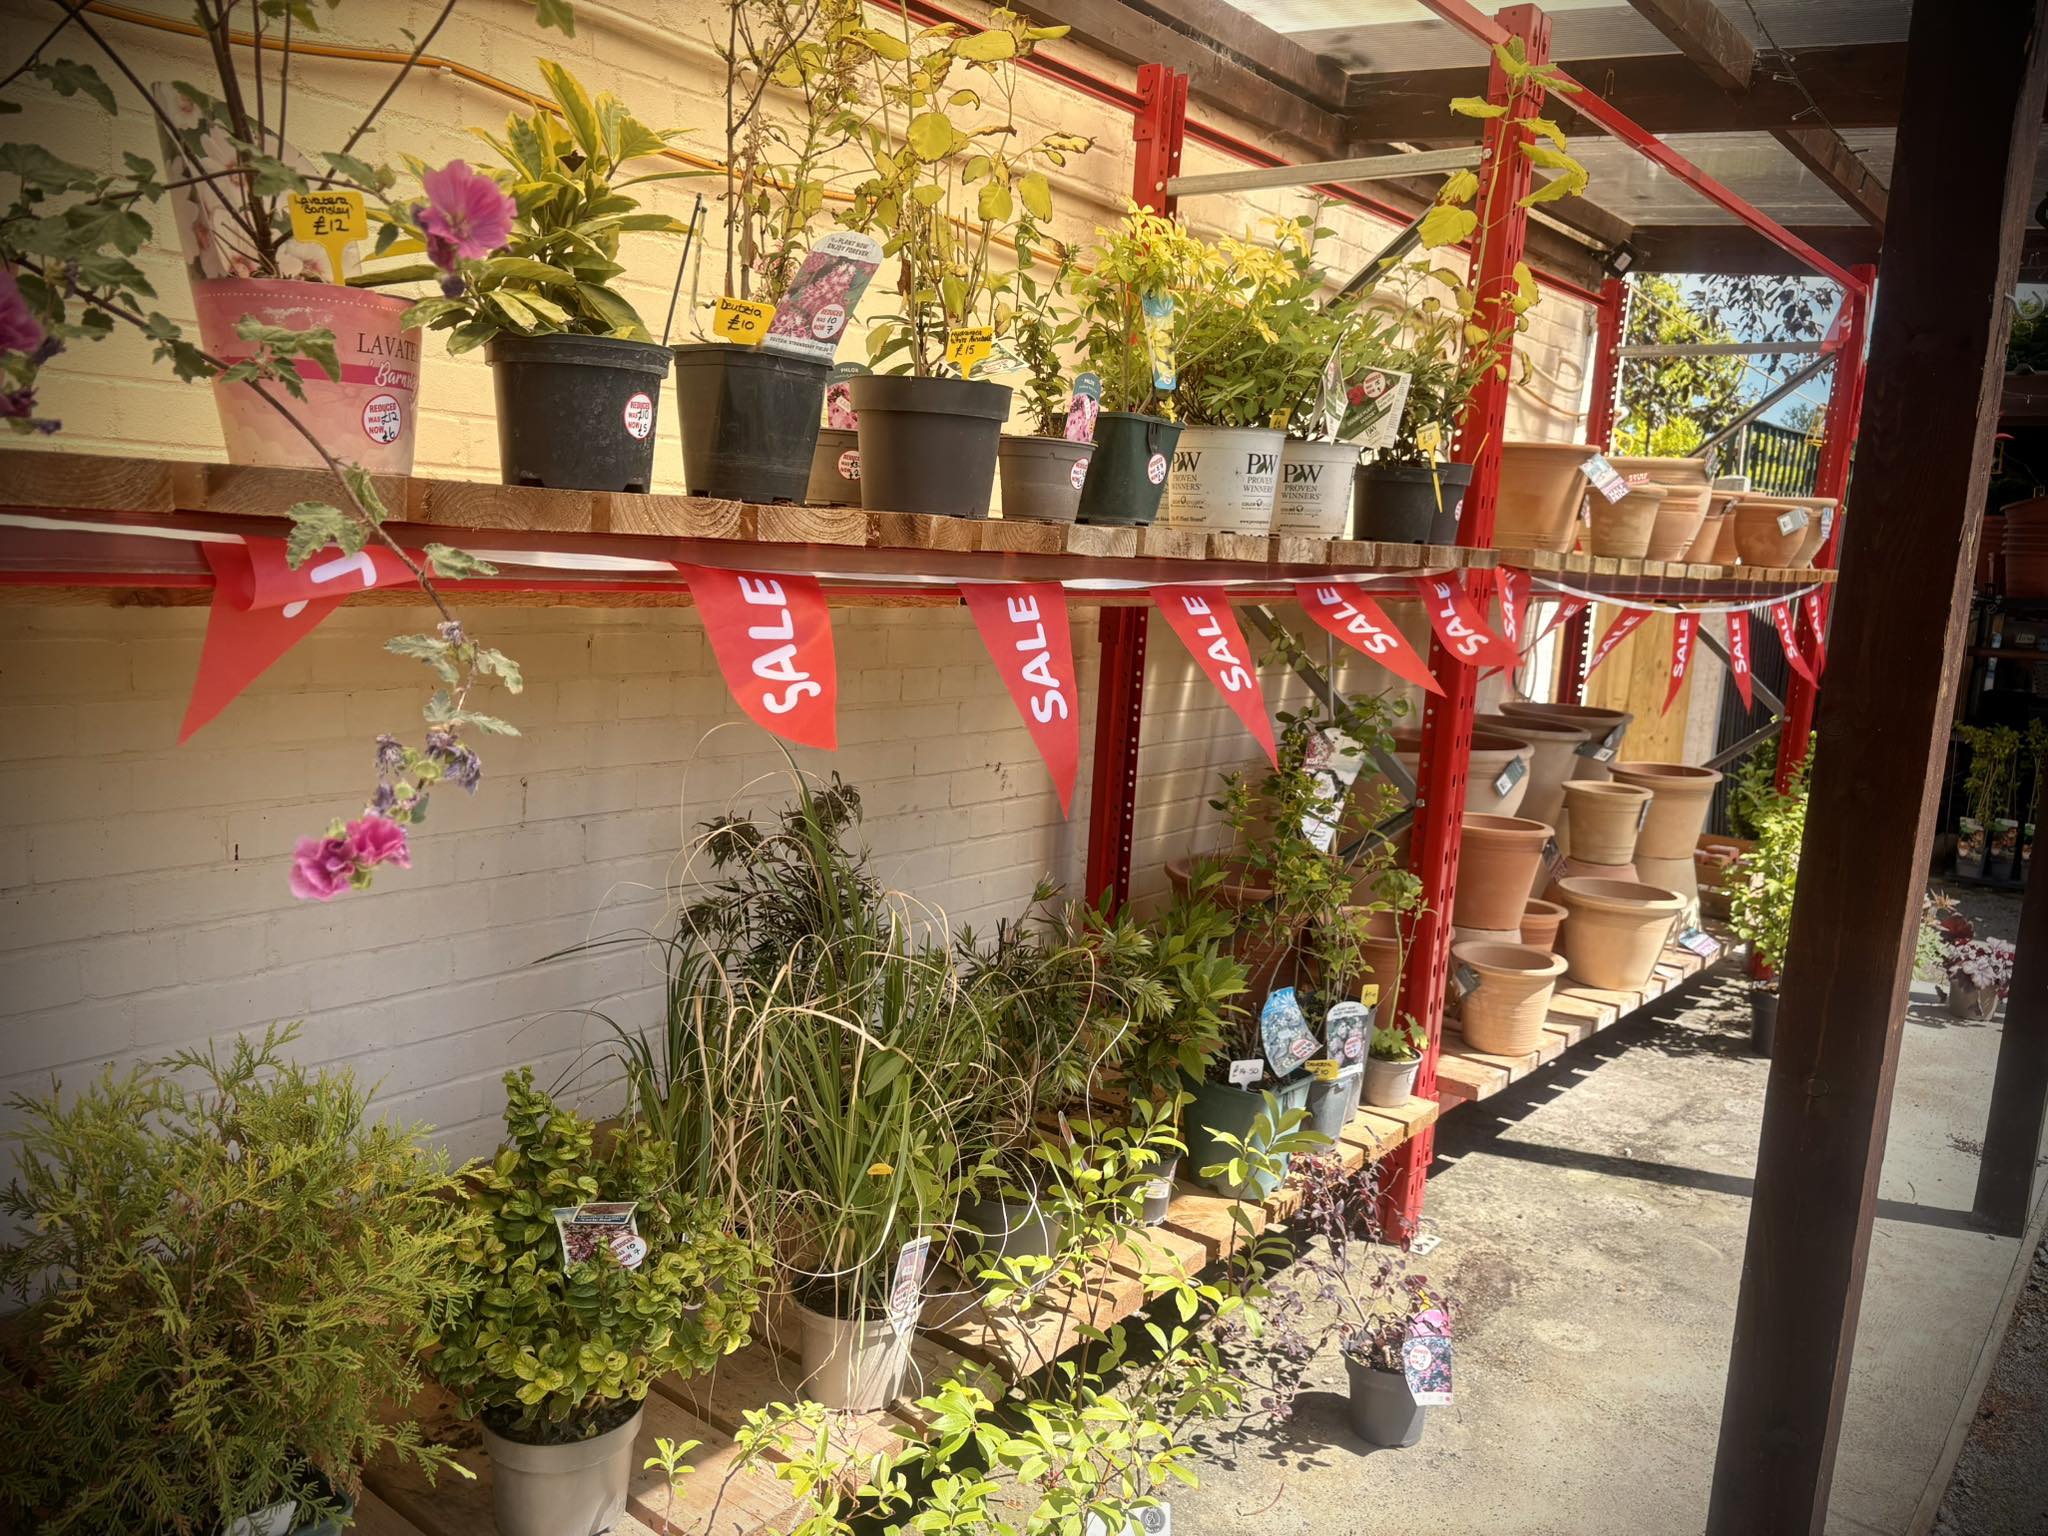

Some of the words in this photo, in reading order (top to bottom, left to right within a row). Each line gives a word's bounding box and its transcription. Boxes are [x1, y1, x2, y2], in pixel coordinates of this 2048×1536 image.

[313, 216, 349, 235] £12
[720, 299, 762, 317] Deutzia
[727, 314, 755, 331] £10
[955, 344, 975, 358] £15
[369, 403, 397, 413] REDUCED
[368, 426, 385, 434] NOW
[1172, 452, 1202, 473] PW
[1246, 453, 1279, 475] PW
[1282, 463, 1324, 484] PW
[1284, 484, 1318, 493] PROVEN
[1316, 586, 1399, 654] SALE
[1433, 581, 1489, 657] SALE
[1181, 595, 1253, 692] SALE
[1777, 607, 1798, 659] SALE
[738, 575, 822, 714] SALE
[1673, 617, 1689, 678] SALE
[1731, 617, 1748, 674] SALE
[1007, 595, 1068, 723] SALE
